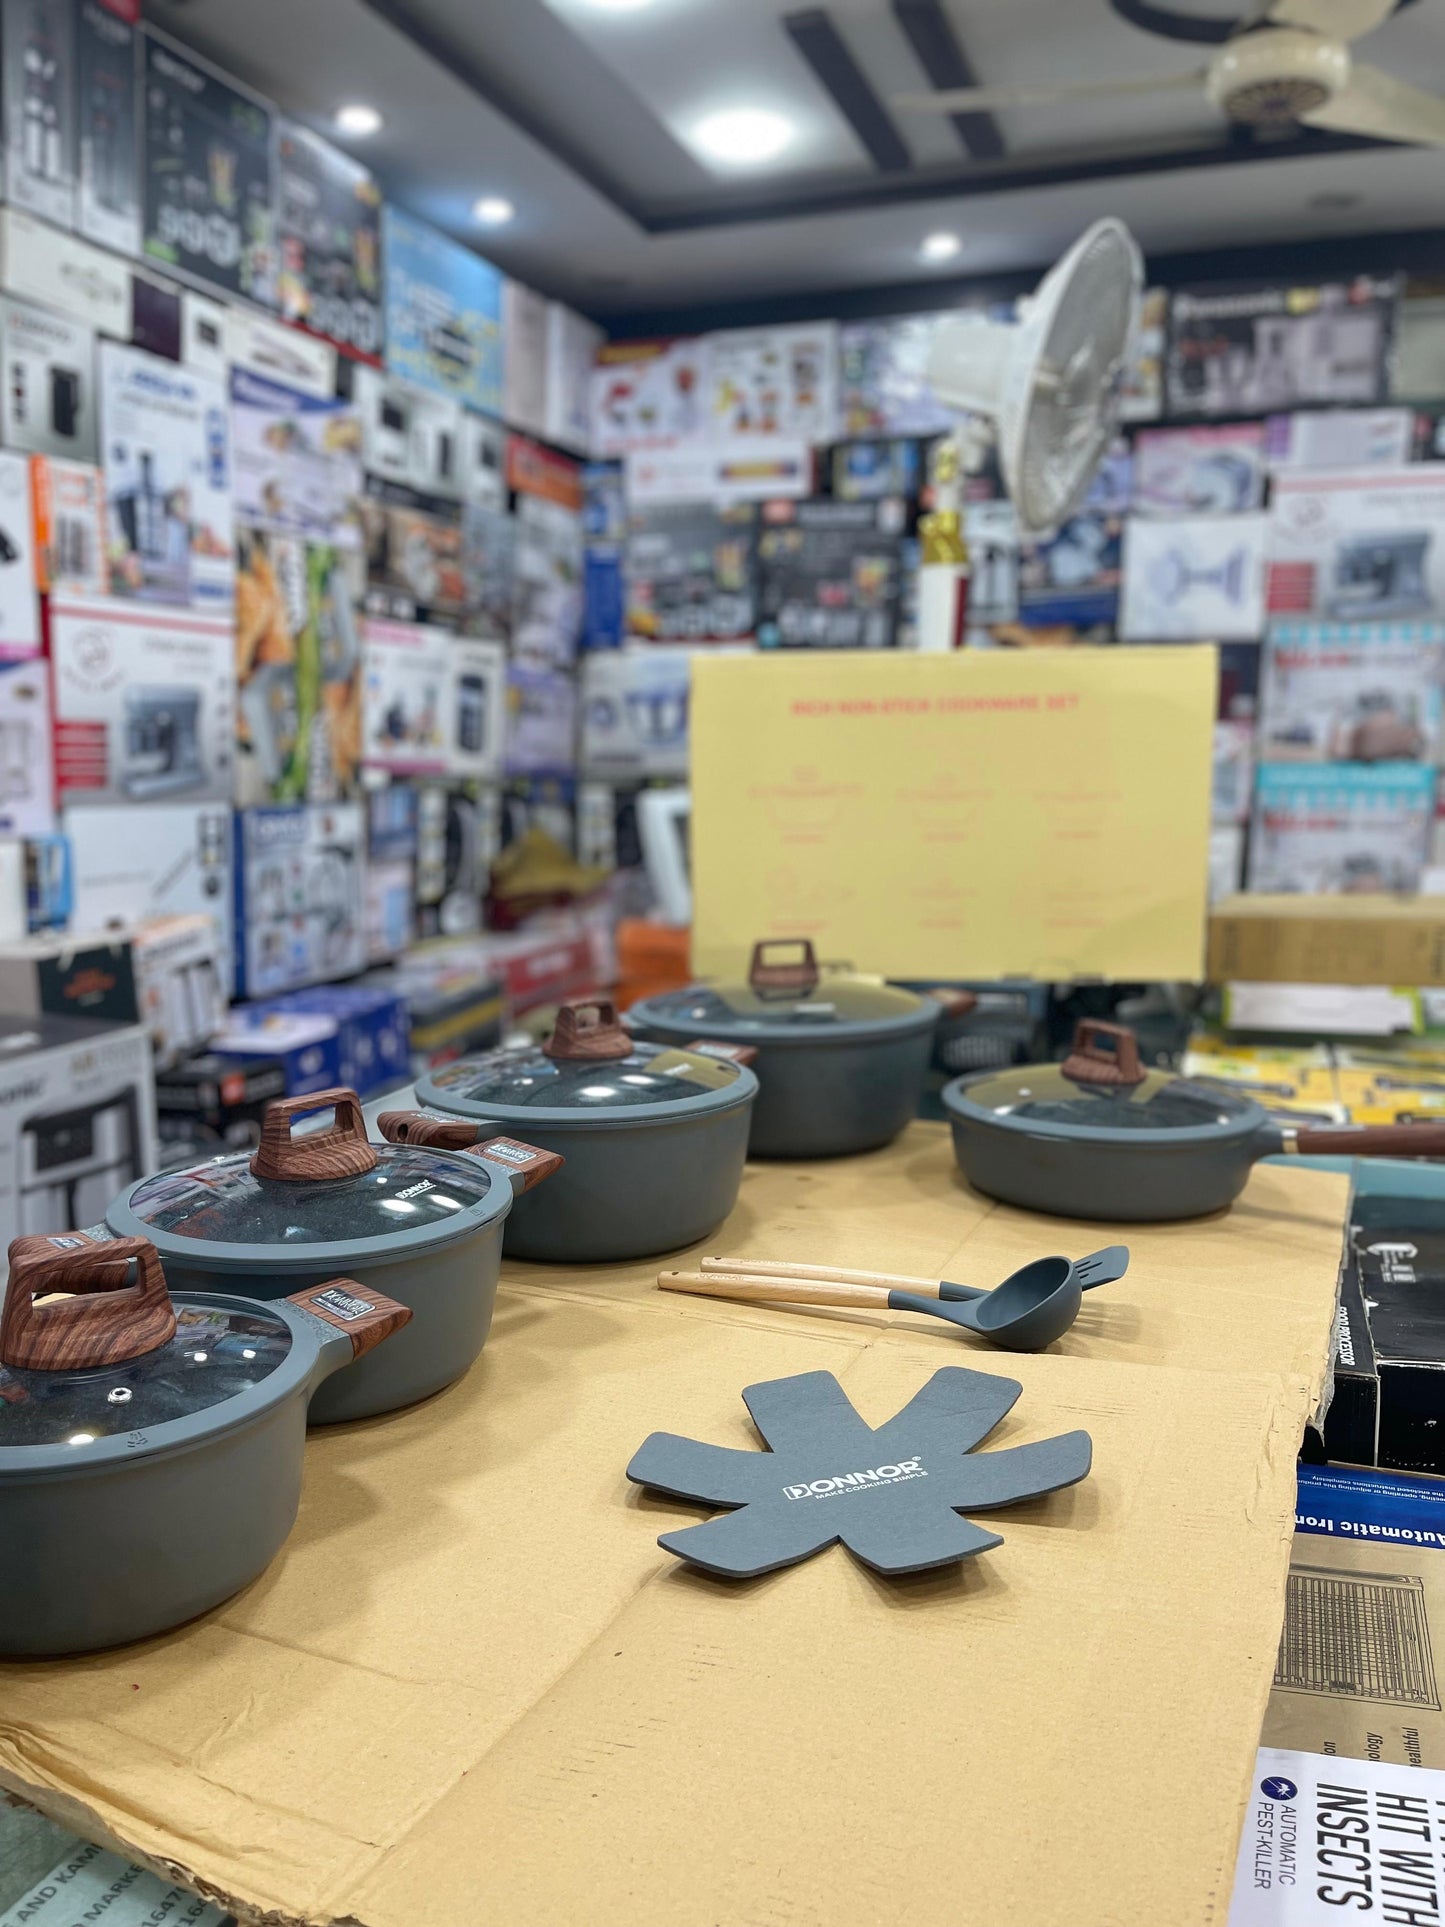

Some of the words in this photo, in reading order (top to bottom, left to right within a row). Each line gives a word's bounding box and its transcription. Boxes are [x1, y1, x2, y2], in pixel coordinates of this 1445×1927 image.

[791, 698, 832, 716] RICH
[1045, 694, 1079, 711] SET
[815, 1489, 845, 1500] MAKE
[845, 1479, 891, 1493] COOKING
[892, 1470, 929, 1483] SIMPLE
[1338, 1484, 1372, 1493] adjusting
[1353, 1480, 1395, 1491] instructions
[1382, 1490, 1418, 1499] operating
[1395, 1486, 1430, 1495] enclosed
[1375, 1791, 1432, 1843] HIT
[1253, 1801, 1275, 1890] PEST-KILLER
[1278, 1804, 1297, 1886] AUTOMATIC
[1316, 1782, 1373, 1911] INSECTS
[17, 1886, 57, 1922] AND
[1379, 1848, 1440, 1927] WITH
